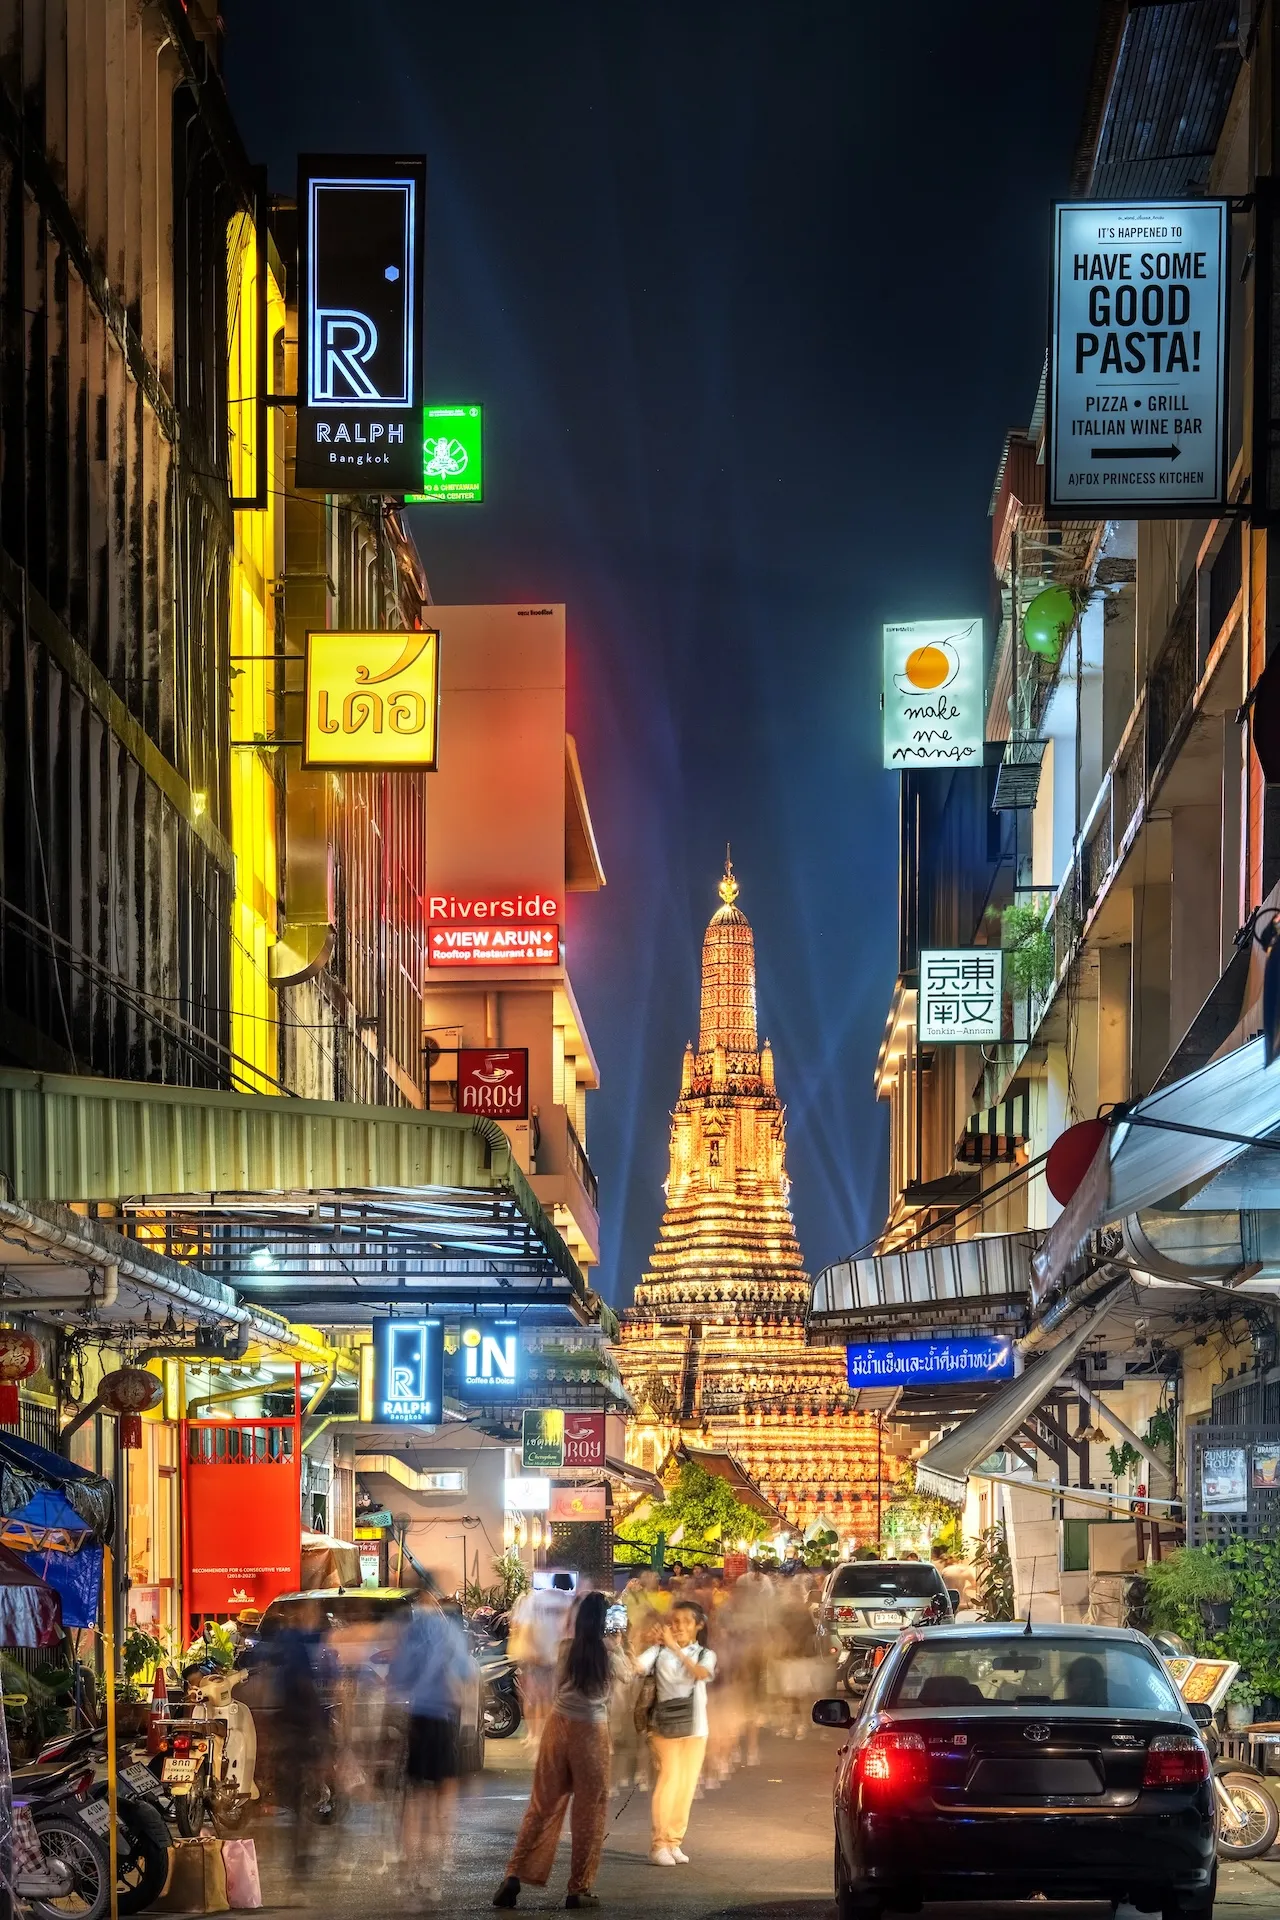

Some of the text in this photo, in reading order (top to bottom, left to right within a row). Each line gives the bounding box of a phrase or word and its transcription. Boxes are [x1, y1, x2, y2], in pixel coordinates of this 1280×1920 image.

[1098, 226, 1182, 239] IT'S HAPPENED TO
[1073, 252, 1207, 281] HAVE SOME
[1088, 284, 1190, 327] GOOD
[314, 309, 382, 399] R
[1075, 331, 1201, 374] PASTA!
[1086, 395, 1189, 412] PIZZA GRILL
[316, 423, 404, 443] RALPH
[1071, 418, 1202, 436] ITALIAN WINE BAR
[329, 452, 390, 465] Bangkok
[1103, 472, 1156, 485] PRINCESS
[1159, 471, 1204, 484] KITCHEN
[446, 492, 475, 500] CENTER
[317, 636, 431, 735] เด้อ
[903, 695, 961, 721] make
[913, 729, 952, 743] me
[429, 895, 557, 919] Riverside
[444, 930, 542, 947] VIEW ARUN
[432, 948, 553, 960] Rooftop Restaurant & Bar
[463, 1085, 522, 1108] AROY
[383, 1402, 431, 1414] RALPH
[390, 1414, 422, 1422] Bangkok
[1204, 1456, 1244, 1468] HOUSE
[167, 1774, 191, 1782] 4412
